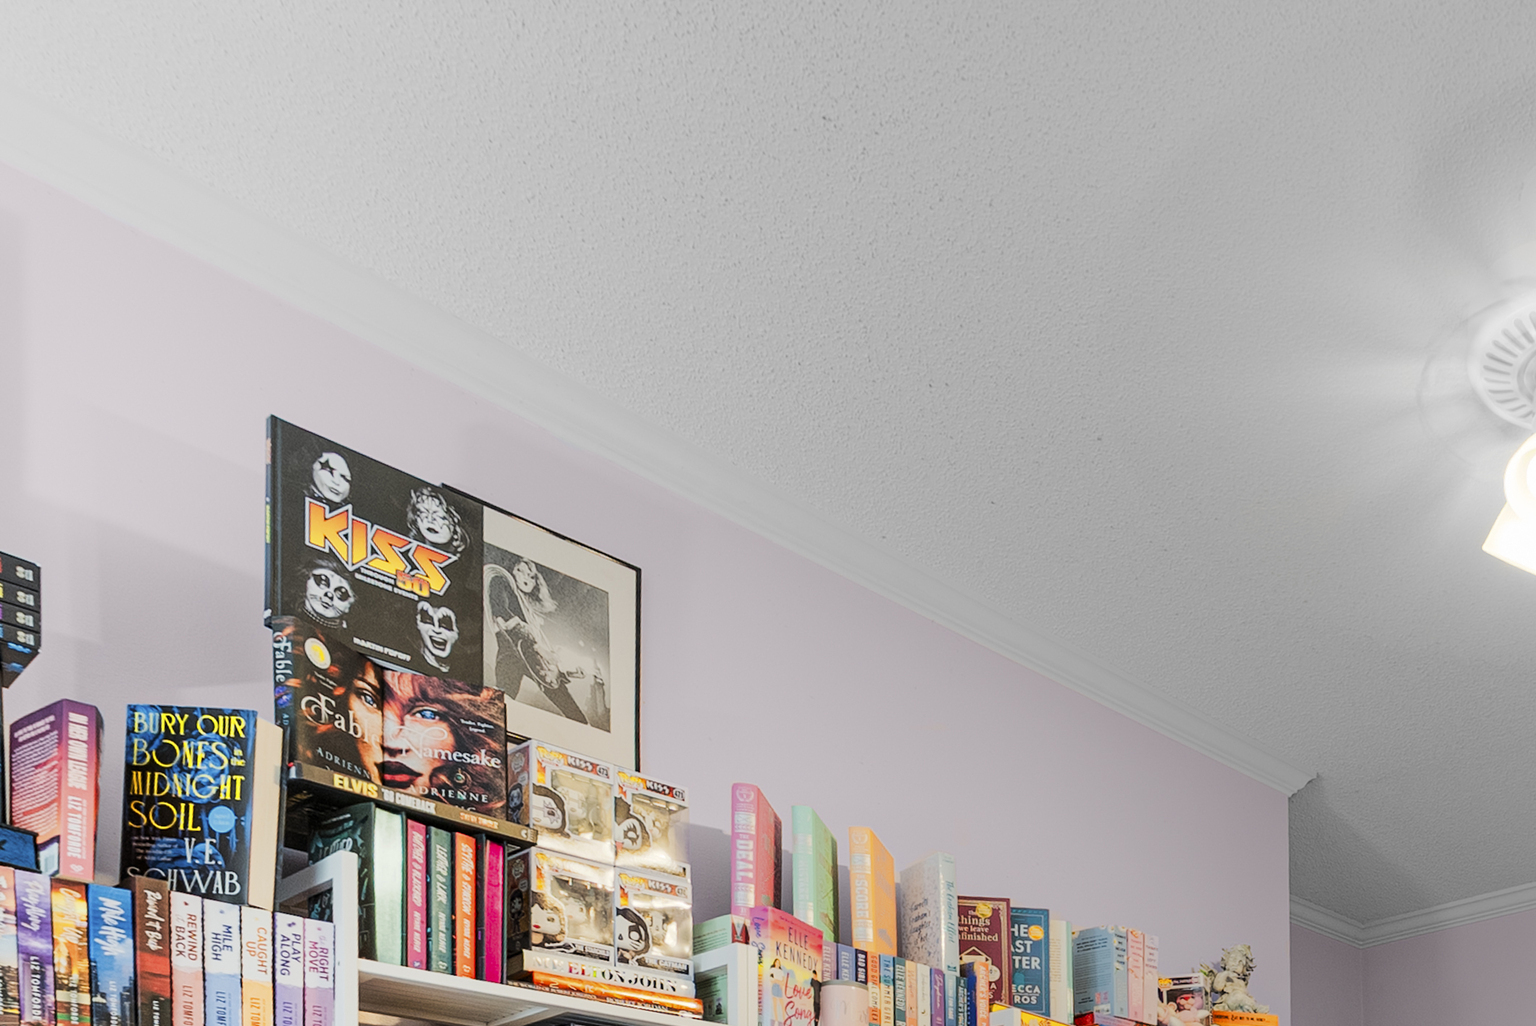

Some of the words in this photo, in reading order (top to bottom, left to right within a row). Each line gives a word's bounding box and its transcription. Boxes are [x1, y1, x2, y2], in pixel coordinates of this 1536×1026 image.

[305, 497, 458, 596] KISS
[396, 571, 430, 597] 50
[274, 631, 293, 683] Fable
[134, 712, 189, 735] BURY
[196, 714, 246, 739] OUR
[301, 693, 380, 745] Fable
[133, 739, 228, 769] BONES
[234, 748, 243, 756] in
[389, 725, 502, 769] Namesake
[231, 757, 245, 767] the
[567, 754, 593, 773] KISS
[130, 771, 245, 800] MIDNIGHT
[333, 774, 378, 798] ELVIS
[395, 792, 436, 814] COMEBACK
[409, 784, 488, 803] ADRIENNE
[646, 780, 671, 795] KISS
[68, 796, 82, 811] LIZ
[128, 801, 201, 831] SOIL
[67, 813, 82, 859] TOMFORDE
[184, 838, 222, 865] V.E.
[736, 839, 753, 881] DEAL
[855, 880, 869, 918] SCORE
[175, 925, 186, 958] BACK
[187, 913, 197, 961] REWIND
[211, 932, 222, 961] HIGH
[222, 924, 233, 952] MILE
[246, 941, 256, 957] UP
[257, 927, 268, 975] CAUGHT
[291, 933, 301, 963] PLAY
[788, 927, 808, 950] ELLE
[30, 956, 39, 969] LIZ
[280, 934, 291, 976] ALONG
[309, 940, 319, 973] MOVE
[319, 947, 329, 981] RIGHT
[775, 941, 818, 972] KENNEDY
[182, 985, 192, 997] LIZ
[568, 960, 626, 985] ELTON
[628, 971, 677, 993] JOHN
[785, 972, 812, 999] Love
[31, 971, 41, 1020] TOMFORDE
[216, 991, 226, 1003] LIZ
[250, 997, 260, 1009] LIZ
[283, 1002, 293, 1013] LIZ
[312, 1005, 322, 1017] LIZ
